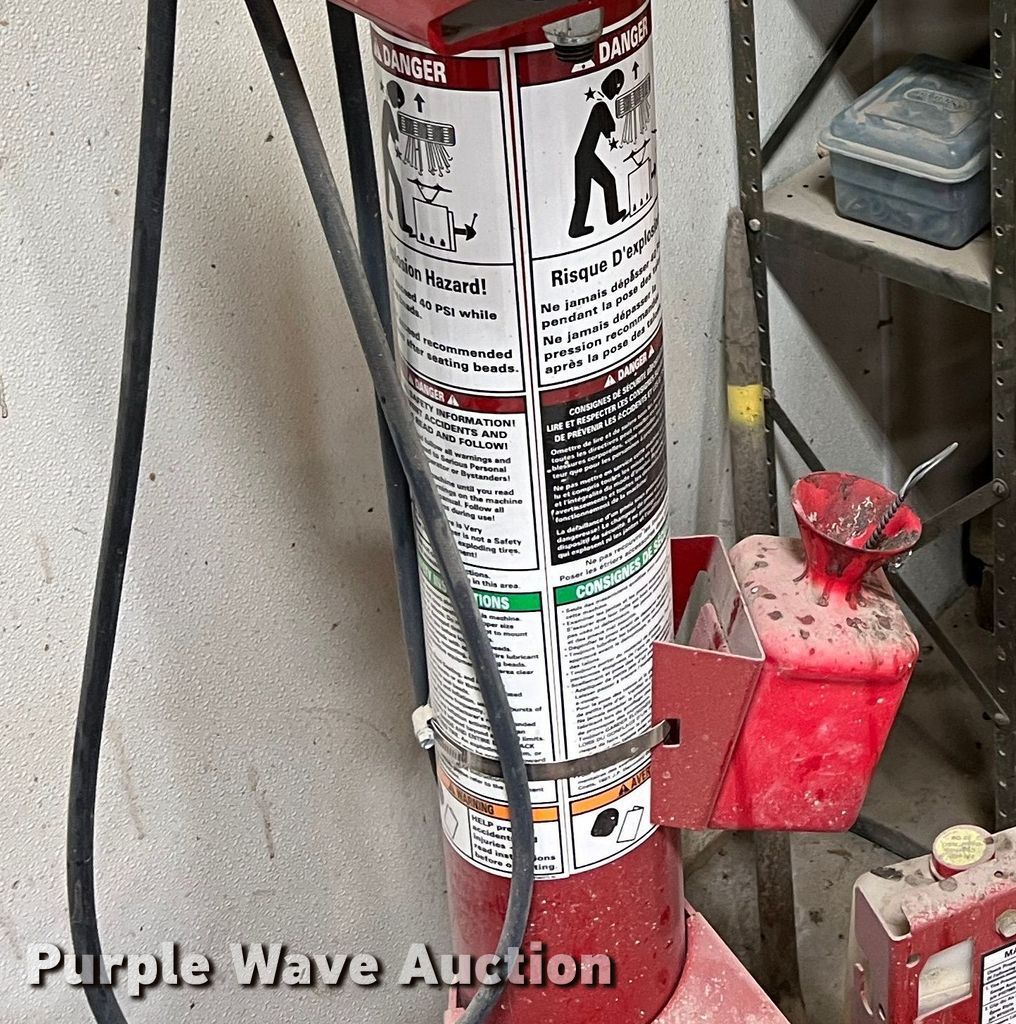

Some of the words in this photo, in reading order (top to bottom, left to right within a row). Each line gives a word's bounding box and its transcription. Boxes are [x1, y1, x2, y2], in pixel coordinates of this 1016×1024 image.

[599, 16, 649, 65] DANGER
[382, 44, 447, 83] DANGER
[425, 268, 487, 296] Hazard!
[552, 260, 607, 287] Risque
[420, 298, 432, 311] 40
[435, 303, 455, 317] PSI
[459, 309, 497, 320] while
[541, 304, 560, 314] Ne
[565, 290, 607, 310] jamais
[541, 307, 598, 330] pendant
[602, 301, 612, 311] la
[616, 285, 638, 306] pose
[640, 274, 651, 288] des
[543, 335, 562, 346] Ne
[567, 322, 609, 343] jamais
[613, 291, 651, 324] dépasser
[423, 337, 513, 359] recommended
[544, 338, 602, 362] pression
[545, 360, 583, 375] après
[588, 354, 599, 364] la
[603, 339, 628, 359] pose
[631, 326, 645, 342] des
[427, 352, 468, 372] seating
[473, 362, 519, 374] beads.
[618, 351, 648, 382] DANGER
[414, 379, 445, 403] DANGER
[546, 422, 563, 433] LIRE
[566, 419, 575, 429] ET
[577, 404, 616, 425] RESPECTER
[617, 397, 628, 409] LES
[569, 394, 611, 416] CONSIGNES
[425, 414, 478, 436] ACCIDENTS
[482, 430, 507, 439] AND
[436, 408, 515, 428] INFORMATION!
[554, 433, 565, 443] DE
[567, 422, 603, 439] PRÉVENIR
[604, 416, 616, 427] LES
[436, 430, 456, 443] AND
[459, 438, 508, 450] FOLLOW!
[551, 444, 581, 456] Omettre
[441, 454, 468, 469] Serious
[470, 464, 506, 473] Personal
[455, 452, 492, 464] warnings
[461, 470, 510, 482] Bystanders!
[569, 467, 583, 476] que
[584, 461, 600, 472] pour
[457, 484, 474, 492] until
[477, 488, 492, 496] you
[566, 482, 578, 490] pas
[572, 483, 599, 496] compris
[451, 507, 475, 520] during
[464, 502, 492, 513] Follow
[464, 524, 482, 534] Very
[458, 540, 496, 554] exploding
[499, 547, 520, 555] tires.
[471, 534, 485, 543] not
[494, 537, 521, 546] Safety
[558, 551, 570, 559] qui
[585, 558, 597, 566] Ne
[599, 551, 612, 561] pas
[482, 580, 497, 588] this
[560, 572, 583, 582] Poser
[586, 566, 597, 575] les
[576, 558, 641, 599] CONSIGNES
[457, 791, 494, 816] WARNING
[471, 815, 494, 828] HELP
[473, 834, 506, 850] injuries
[473, 844, 493, 855] read
[475, 851, 504, 866] before
